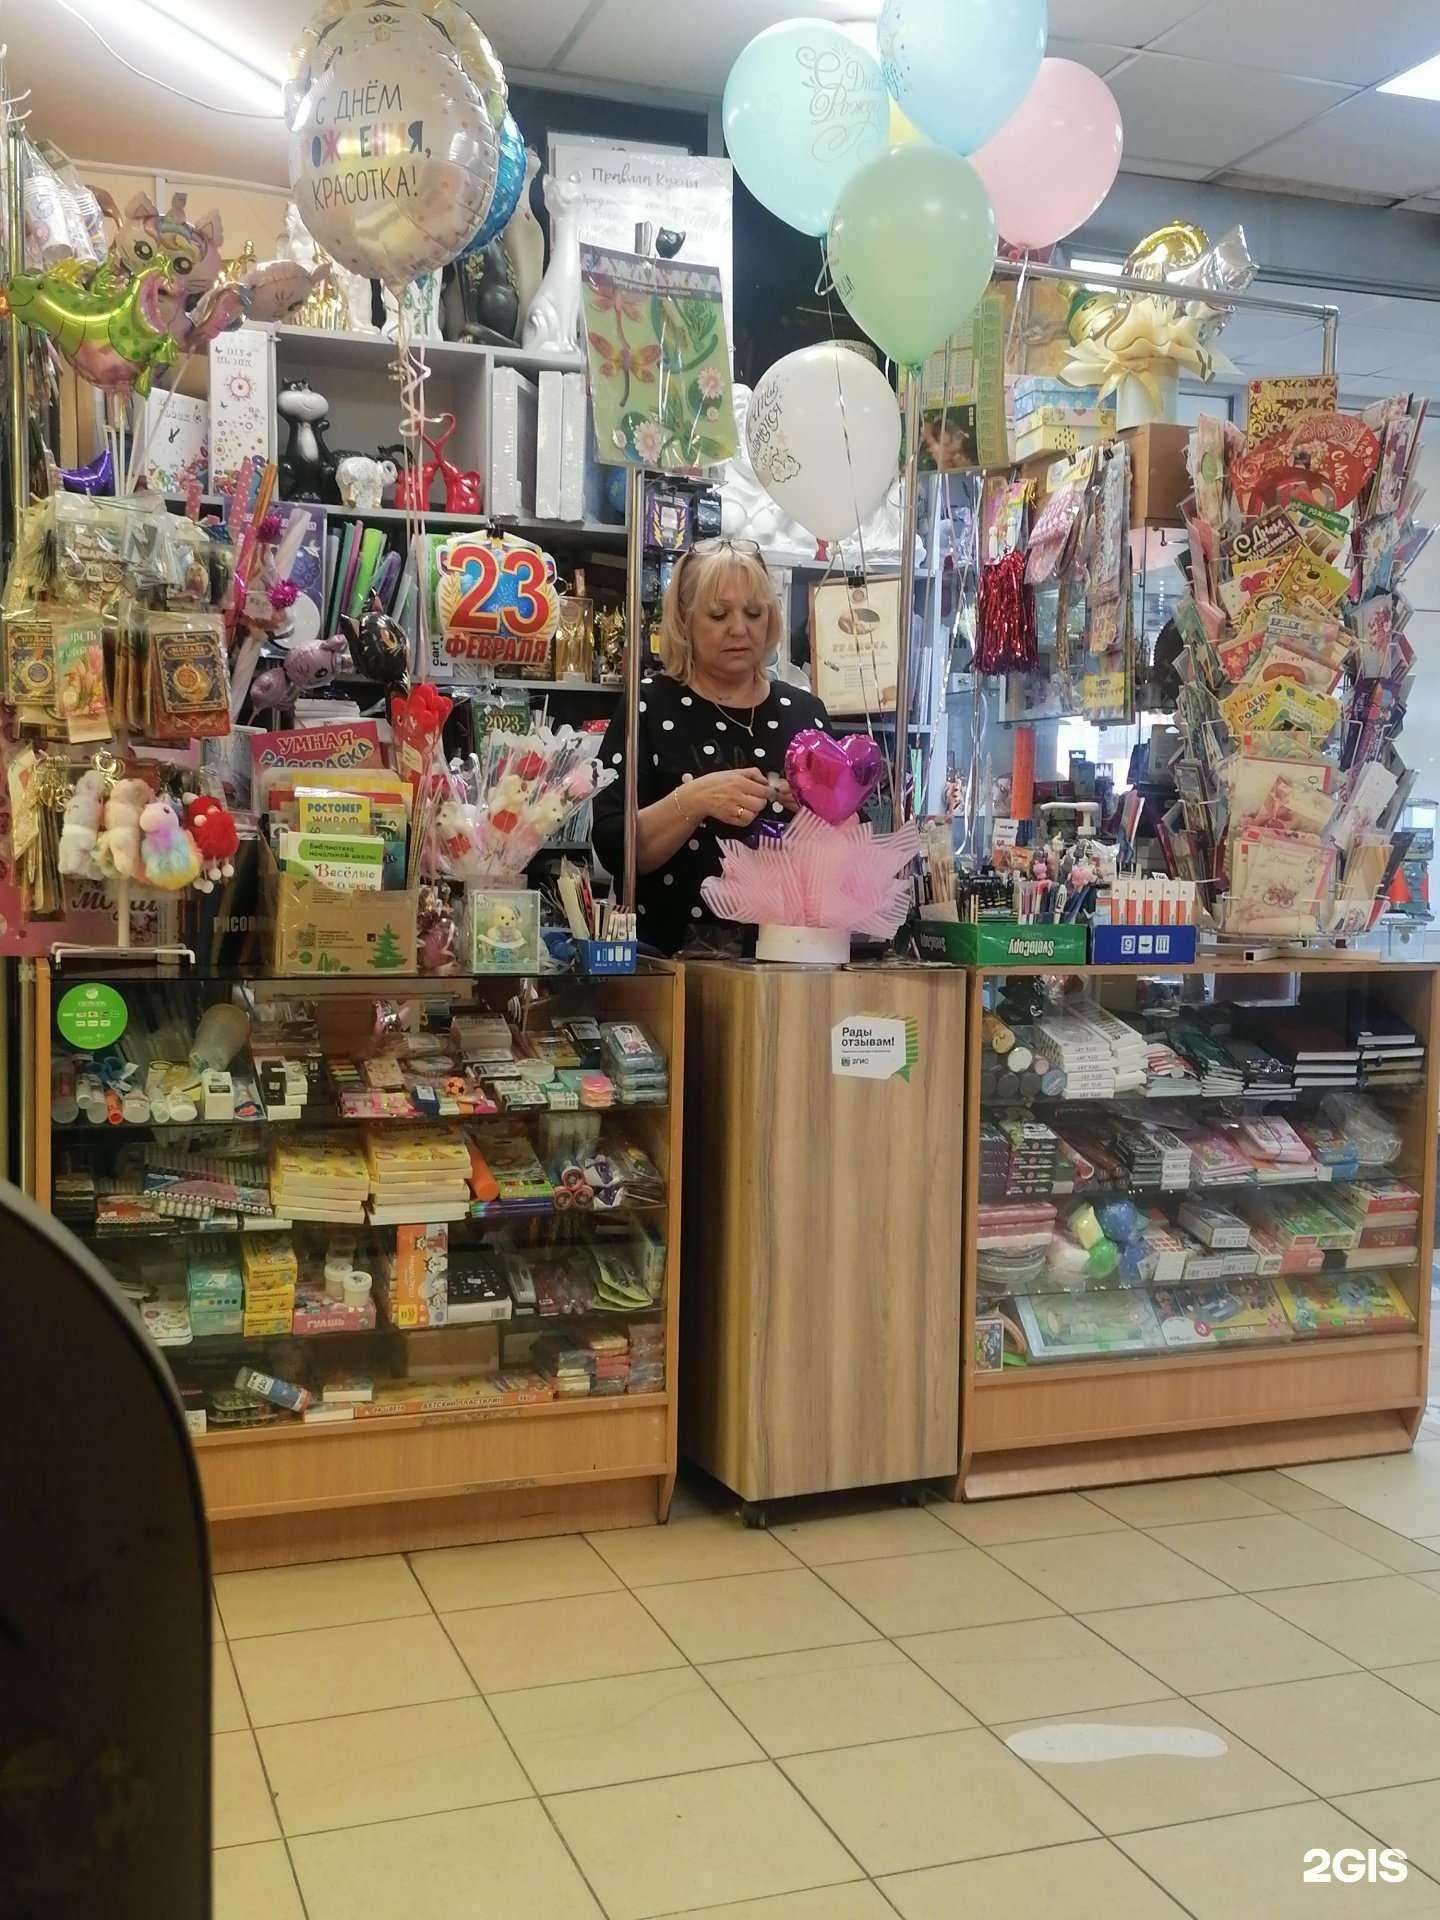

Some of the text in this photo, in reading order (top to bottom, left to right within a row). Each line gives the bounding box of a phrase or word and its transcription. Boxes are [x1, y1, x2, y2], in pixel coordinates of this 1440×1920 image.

[334, 80, 402, 124] ДНЁМ
[312, 166, 418, 210] КРАСОТКА!
[448, 544, 551, 636] 23
[445, 634, 550, 664] ФЕВРАЛЯ
[485, 714, 520, 732] 2023
[276, 728, 354, 755] УМНАЯ
[307, 803, 362, 813] РОСТОМЕР
[841, 1037, 895, 1047] отзывам!
[842, 1027, 872, 1038] Рады
